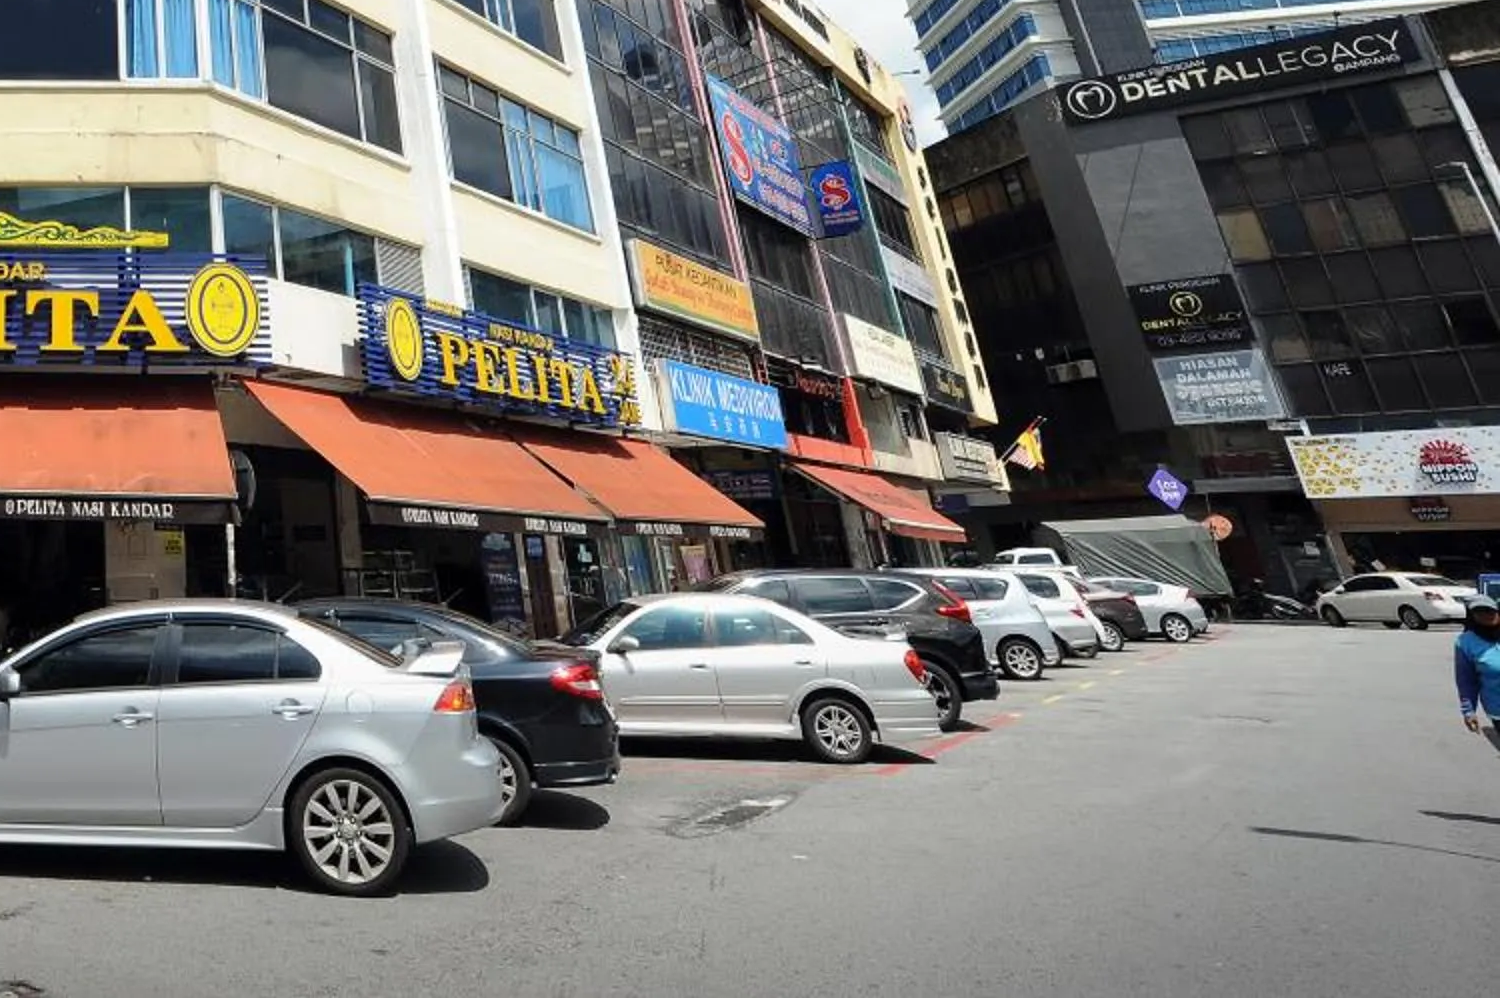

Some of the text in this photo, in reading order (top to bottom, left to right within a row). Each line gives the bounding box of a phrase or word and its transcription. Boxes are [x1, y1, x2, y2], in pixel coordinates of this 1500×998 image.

[436, 331, 607, 415] PELITA
[1179, 356, 1239, 371] HIASAN
[1175, 368, 1251, 384] DALAMAN
[670, 365, 717, 409] KLINIK
[717, 377, 784, 422] MEDIVIRON
[17, 499, 174, 519] PELITA NASI KANDAR
